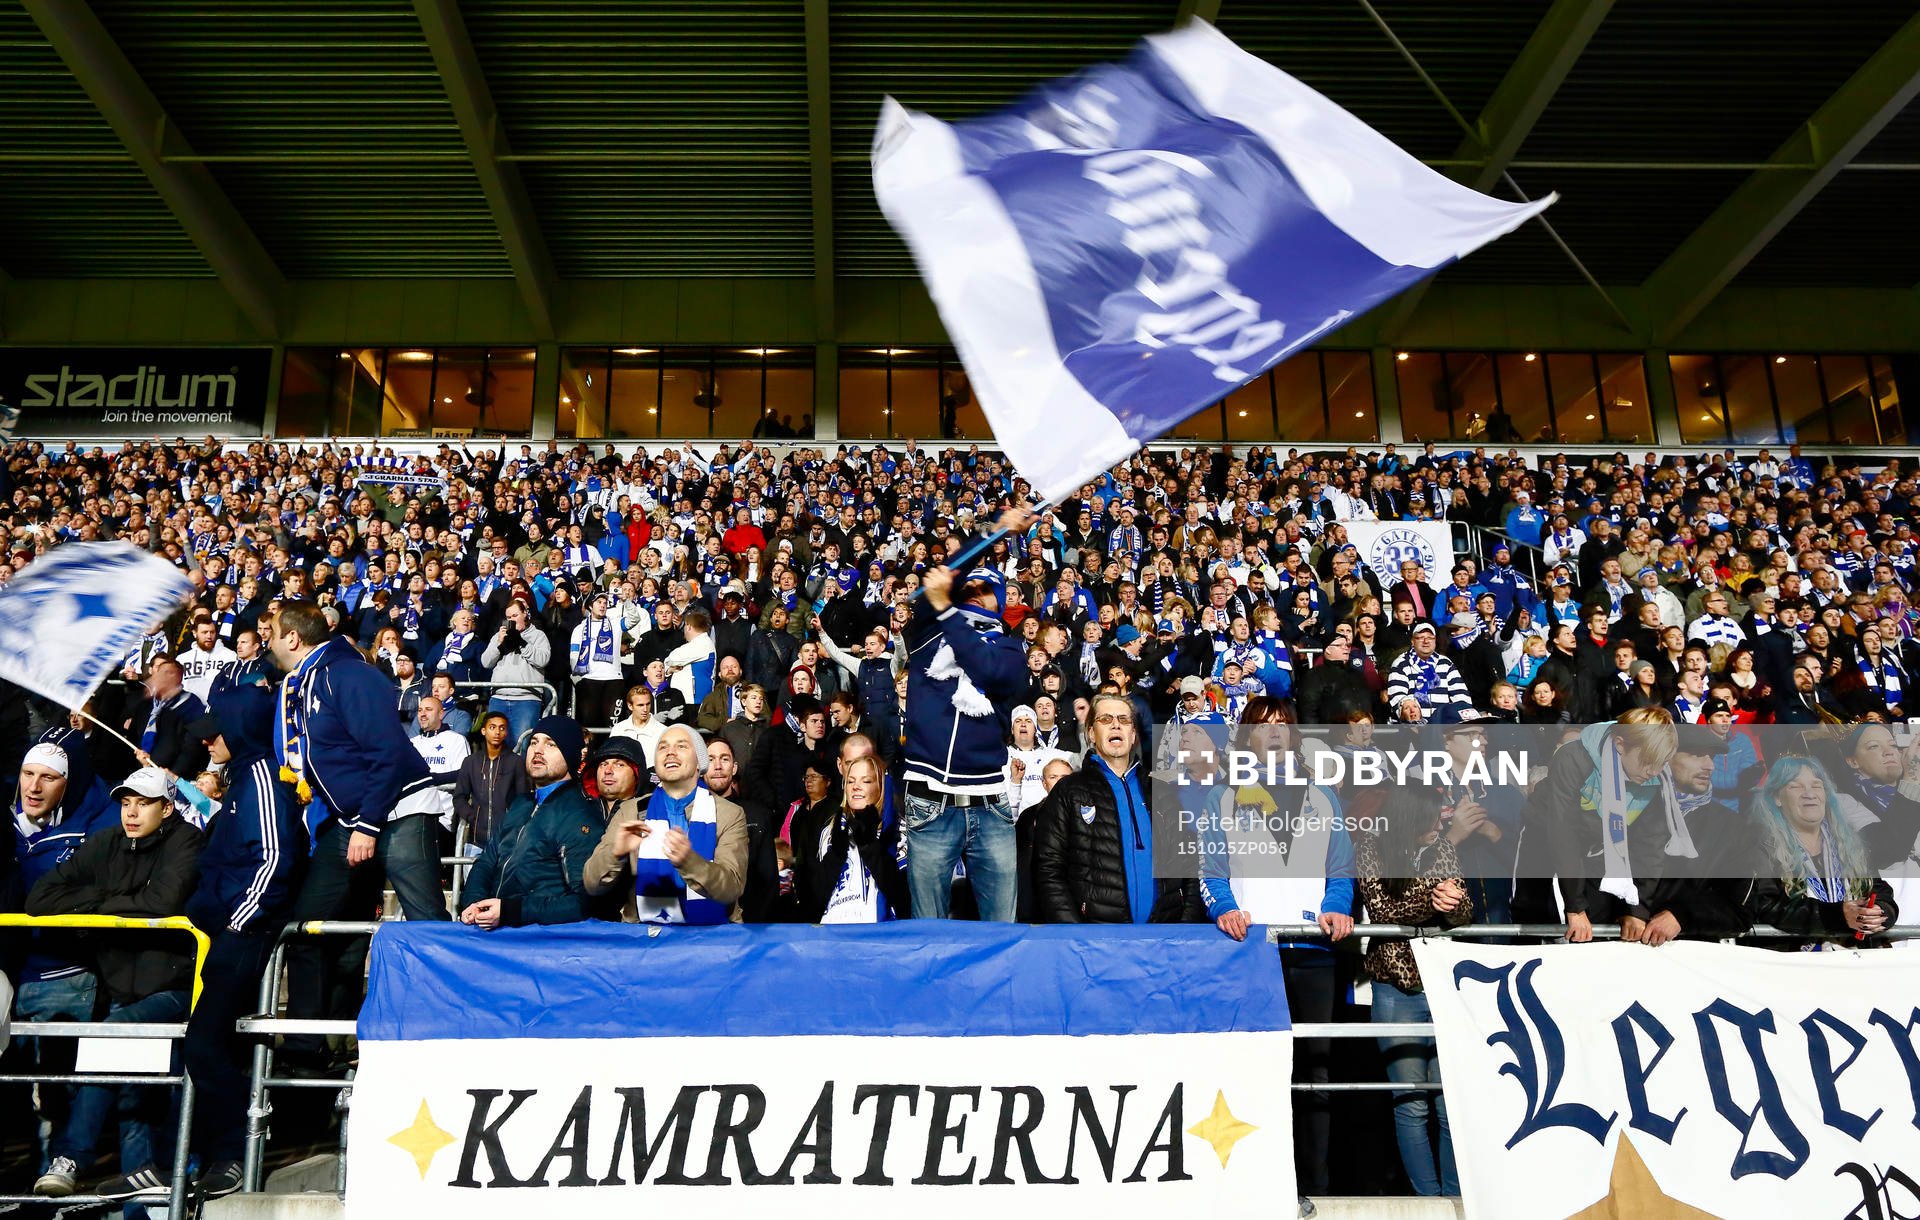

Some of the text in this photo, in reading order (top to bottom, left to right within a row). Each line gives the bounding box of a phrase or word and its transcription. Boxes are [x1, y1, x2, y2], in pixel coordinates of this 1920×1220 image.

[21, 366, 236, 407] stadium
[101, 410, 232, 422] Join the movement
[1381, 531, 1420, 545] GATE
[448, 1080, 1193, 1189] KAMRATERNA
